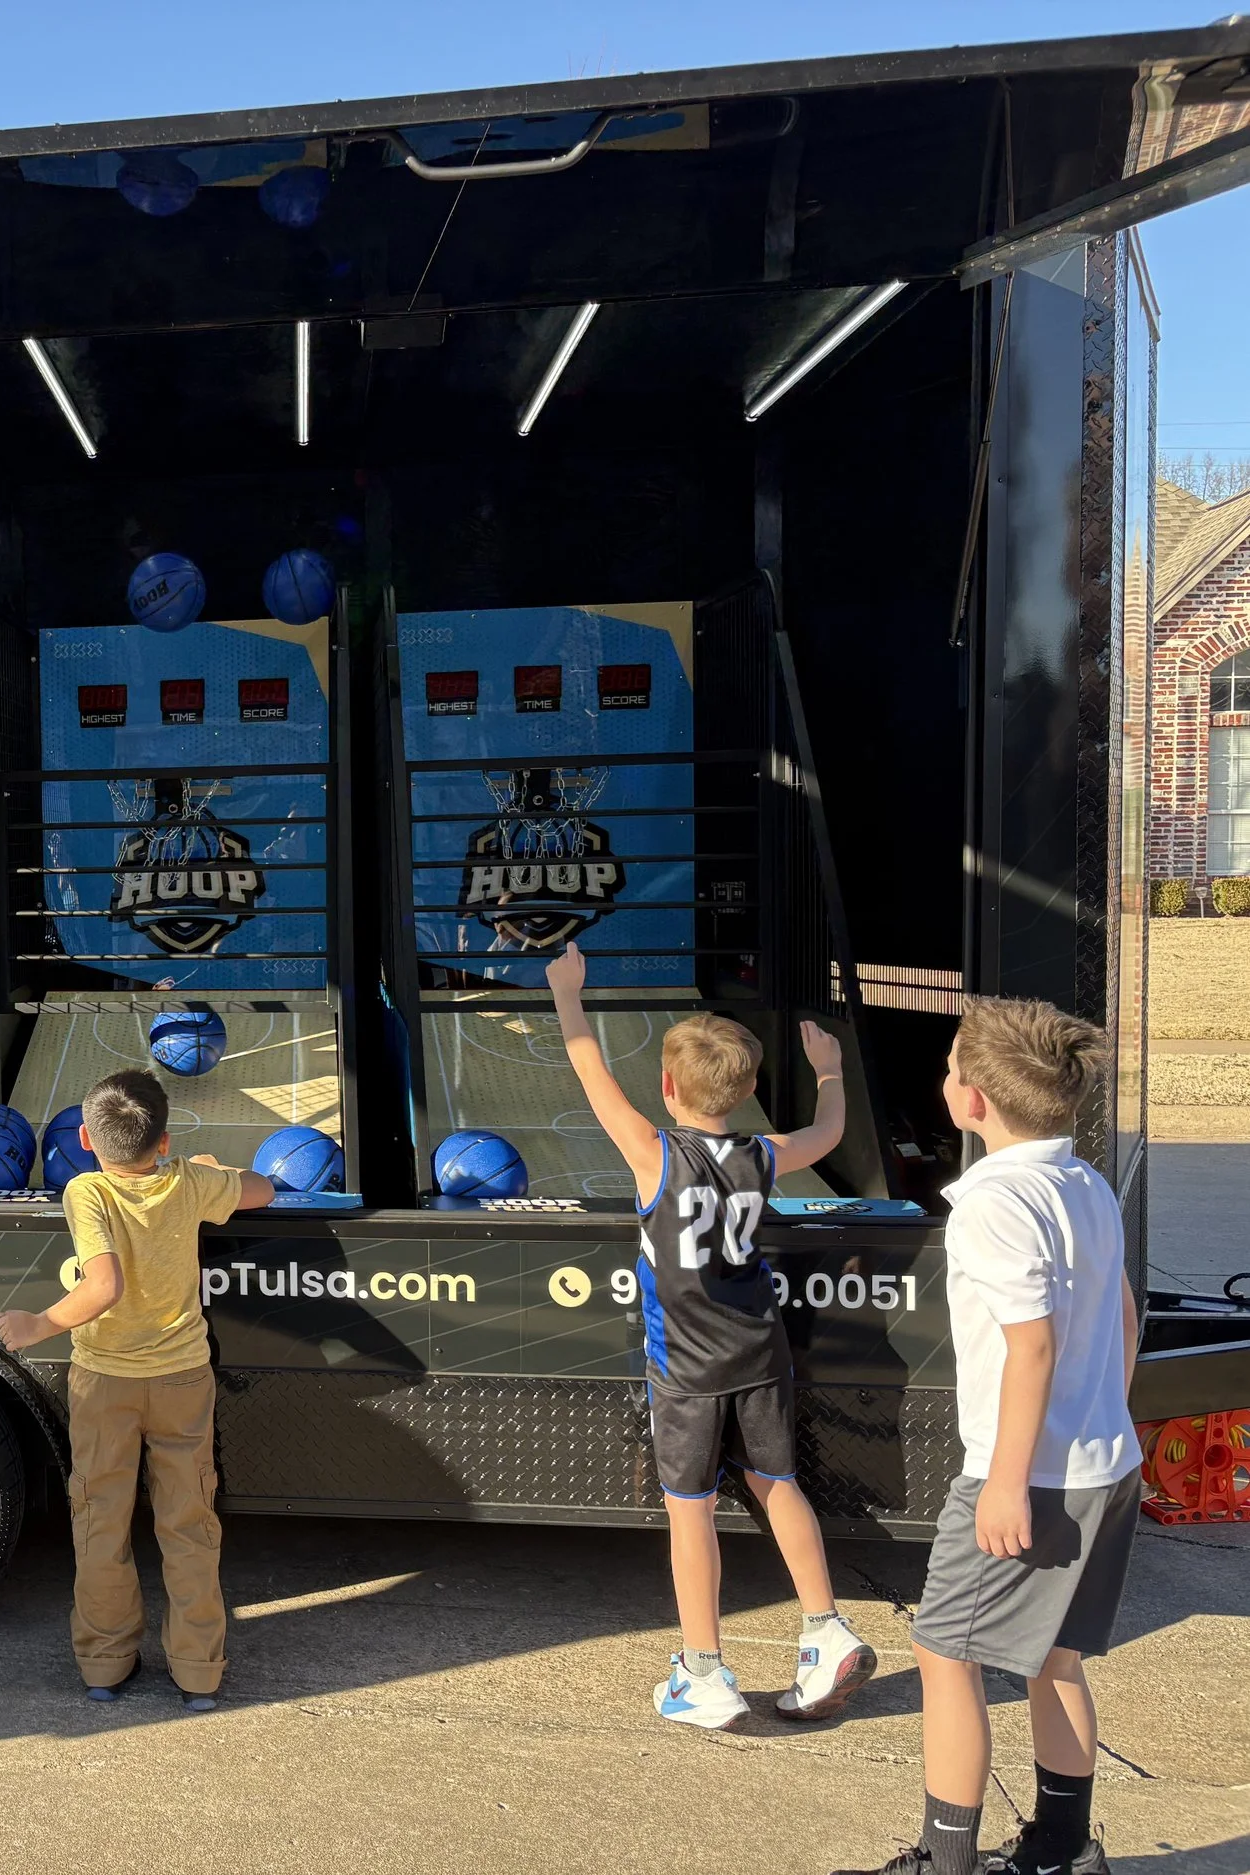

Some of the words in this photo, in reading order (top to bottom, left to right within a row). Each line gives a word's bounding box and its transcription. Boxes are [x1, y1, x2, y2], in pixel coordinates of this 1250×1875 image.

[524, 700, 552, 709] TIME
[602, 695, 646, 705] SCORE
[429, 701, 475, 712] HIGHEST
[170, 713, 196, 722] TIME
[243, 708, 284, 718] SCORE
[81, 714, 125, 723] HIGHEST
[466, 863, 617, 904] HOOP
[117, 871, 258, 909] HOOP
[480, 1205, 588, 1213] TULSA
[678, 1186, 764, 1268] 20
[202, 1261, 476, 1307] pTulsa.com
[610, 1268, 916, 1311] 99.0051
